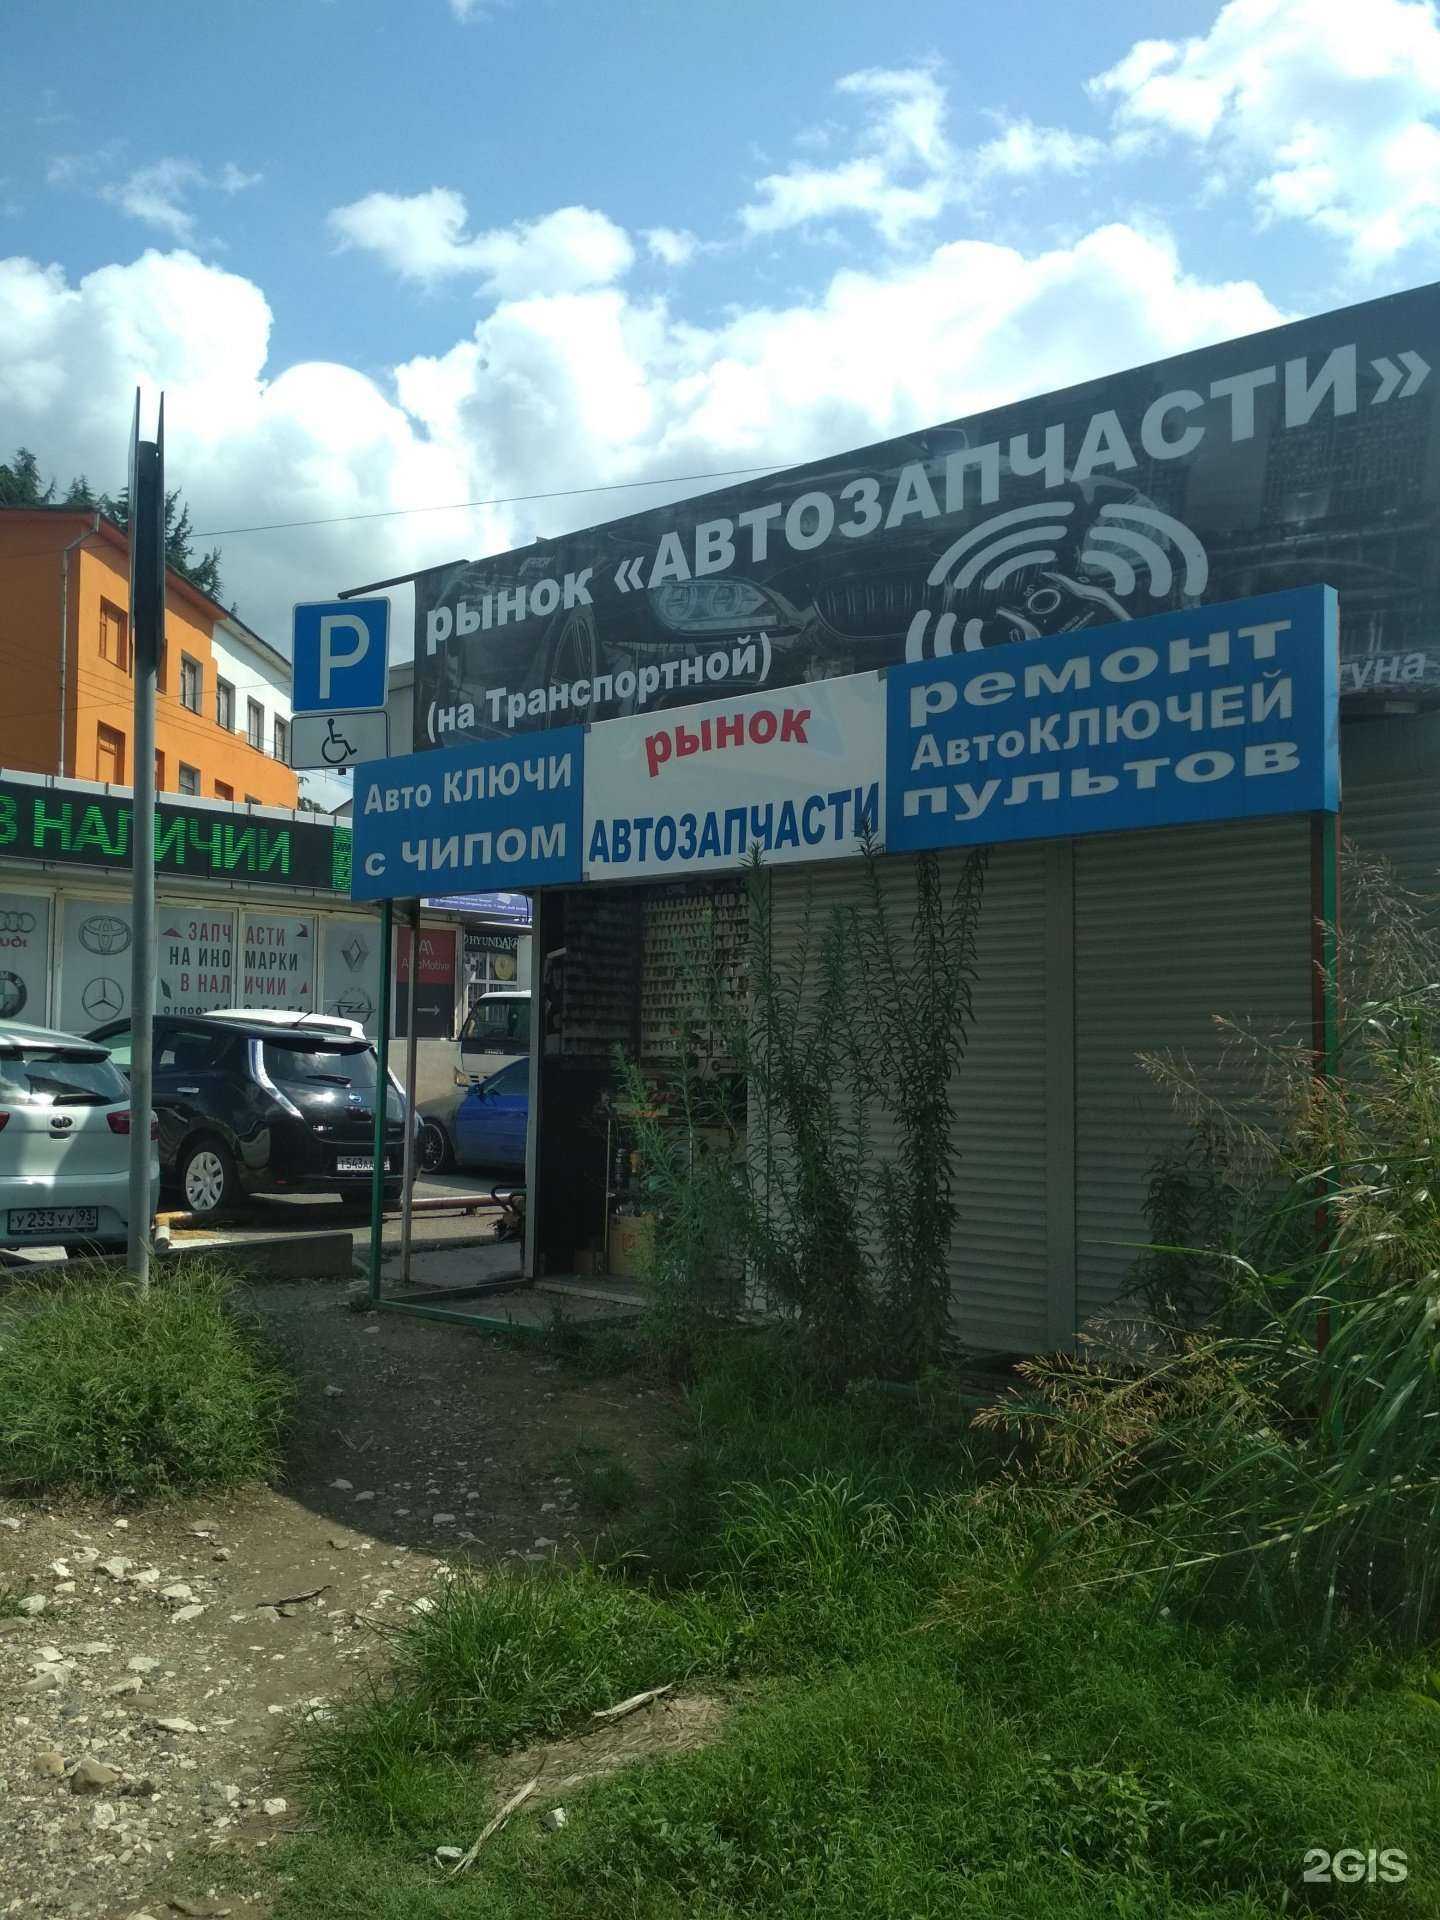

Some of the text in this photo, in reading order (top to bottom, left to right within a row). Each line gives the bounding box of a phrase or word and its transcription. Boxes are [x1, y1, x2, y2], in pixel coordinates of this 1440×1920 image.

[426, 343, 1432, 655] рынок «АВТОЗАПЧАСТИ»
[427, 632, 773, 743] (на Транспортной)
[909, 619, 1292, 729] ремонт
[643, 706, 811, 778] рынок
[911, 669, 1293, 772] АвтоКЛЮЧЕЙ
[363, 753, 572, 816] Авто КЛЮЧИ
[903, 741, 1300, 822] пультов
[364, 851, 387, 877] с
[401, 822, 567, 877] ЧИПОМ
[589, 782, 879, 864] АВТОЗАПЧАСТИ
[0, 935, 27, 948] udi
[169, 946, 191, 966] НА
[180, 973, 190, 992] В
